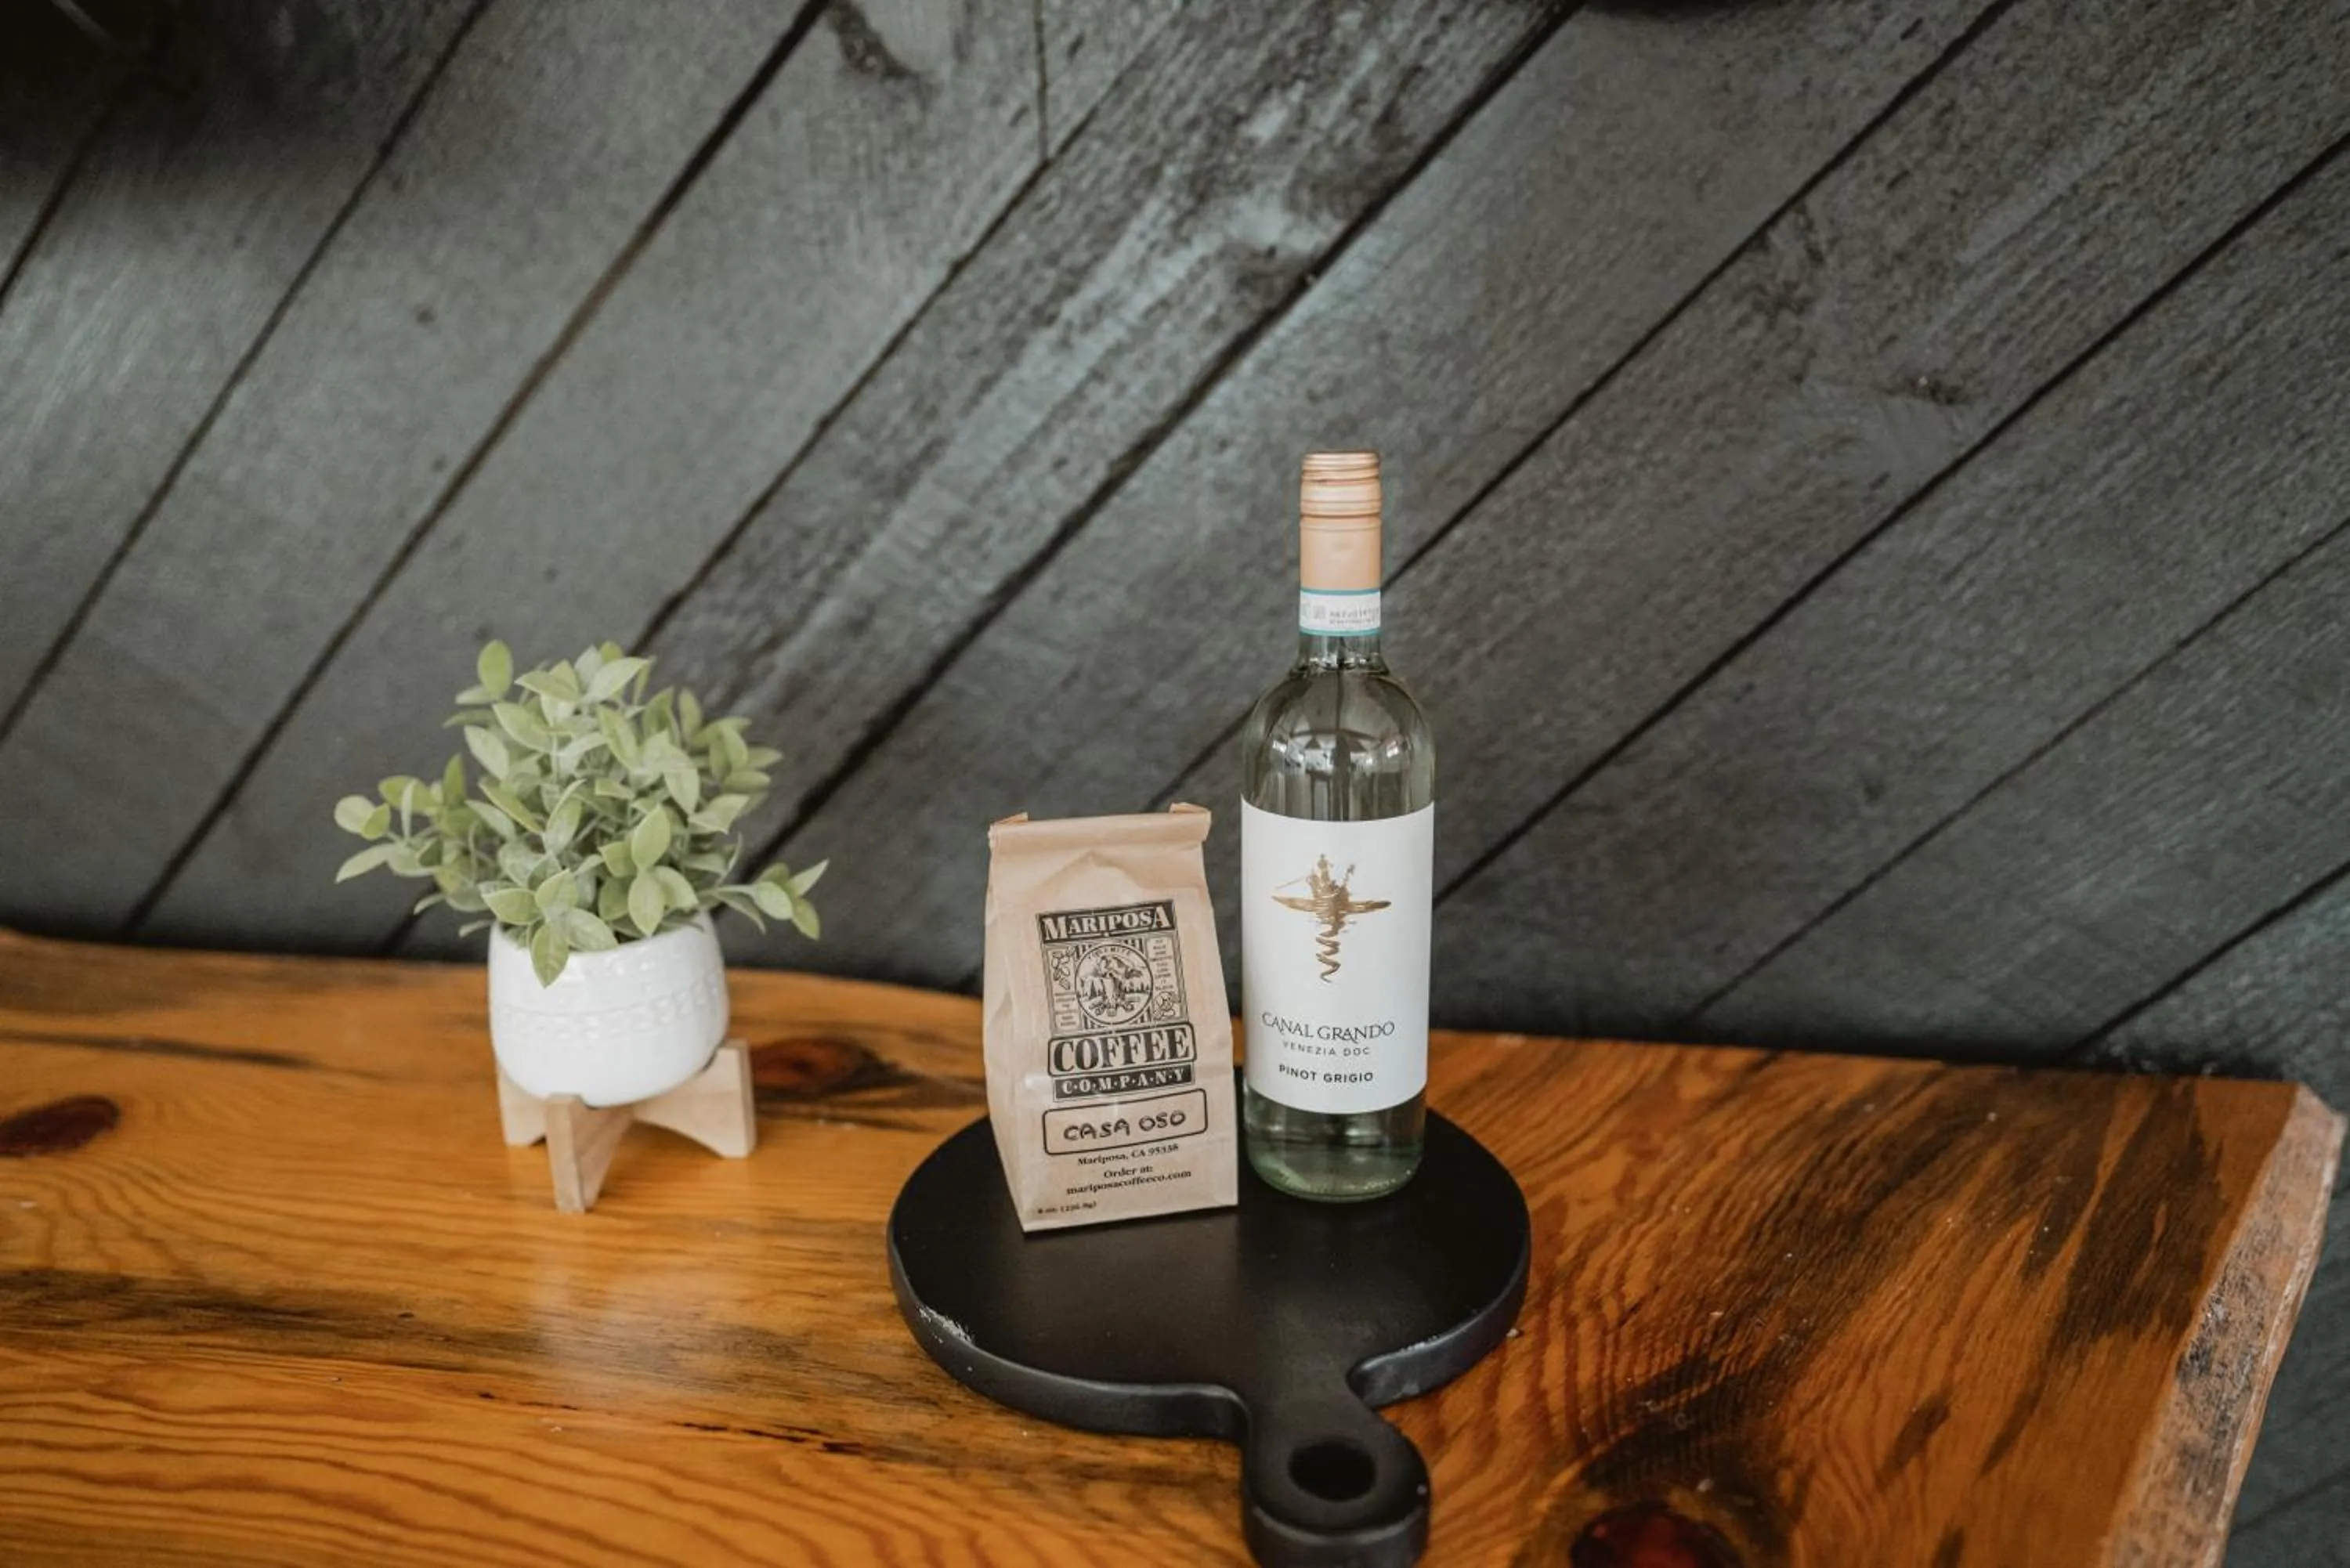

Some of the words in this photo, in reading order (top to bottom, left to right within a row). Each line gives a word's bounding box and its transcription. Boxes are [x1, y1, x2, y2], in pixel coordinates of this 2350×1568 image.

[1043, 905, 1170, 940] MARIPOSA
[1262, 1011, 1314, 1038] CANAL
[1317, 1021, 1395, 1043] GRANDO
[1054, 1028, 1190, 1072] COFFEE
[1282, 1041, 1336, 1057] VENEZIA
[1343, 1046, 1371, 1057] DOC
[1278, 1064, 1318, 1081] PINOT
[1323, 1071, 1374, 1083] GRIGIO
[1063, 1118, 1130, 1141] CASA
[1138, 1110, 1187, 1132] OSO
[1077, 1154, 1129, 1166] Mariposa,
[1131, 1149, 1146, 1159] CA
[1065, 1170, 1192, 1195] mariposacoffeeco.com
[1103, 1167, 1137, 1179] Order
[1140, 1165, 1154, 1174] at:
